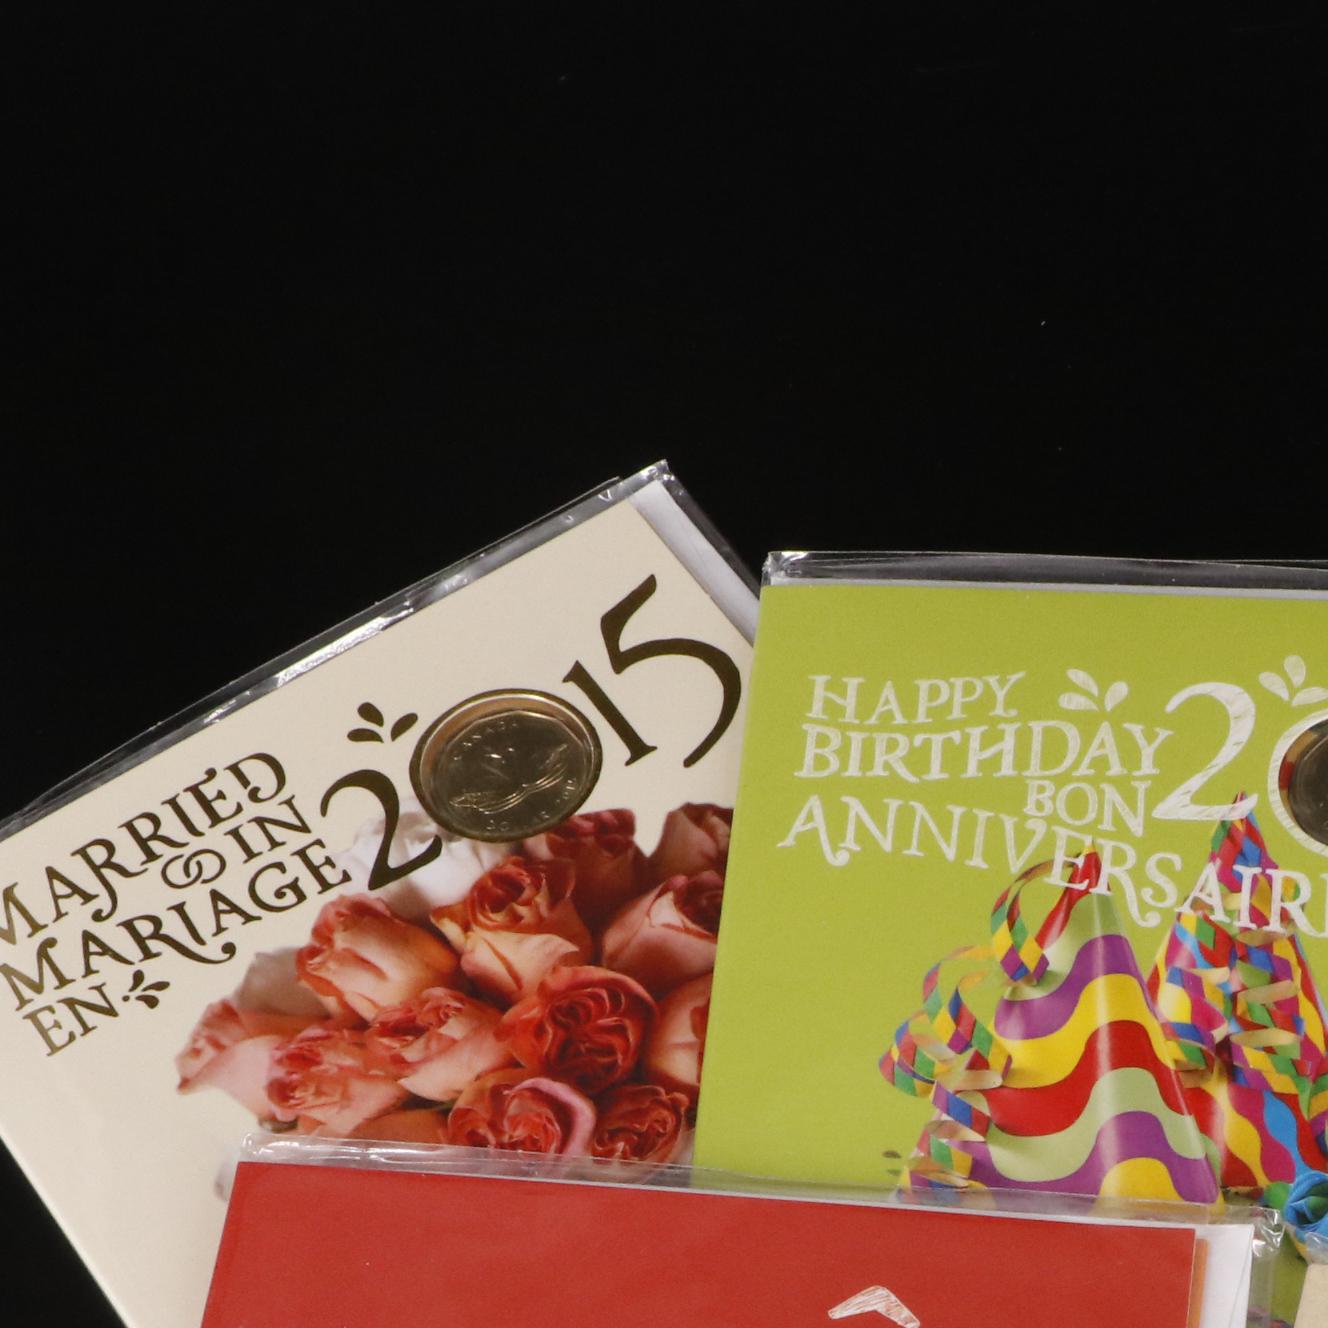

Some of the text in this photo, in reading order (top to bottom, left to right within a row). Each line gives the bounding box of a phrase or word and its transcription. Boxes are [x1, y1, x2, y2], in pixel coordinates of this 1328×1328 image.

[806, 670, 1027, 727] HAPPY
[795, 720, 1173, 784] BIRTHDAY
[225, 796, 312, 863] IN
[1023, 779, 1151, 838] BON
[0, 752, 287, 945] MARRIED
[0, 838, 352, 1012] MARIAGE
[23, 982, 119, 1057] EN
